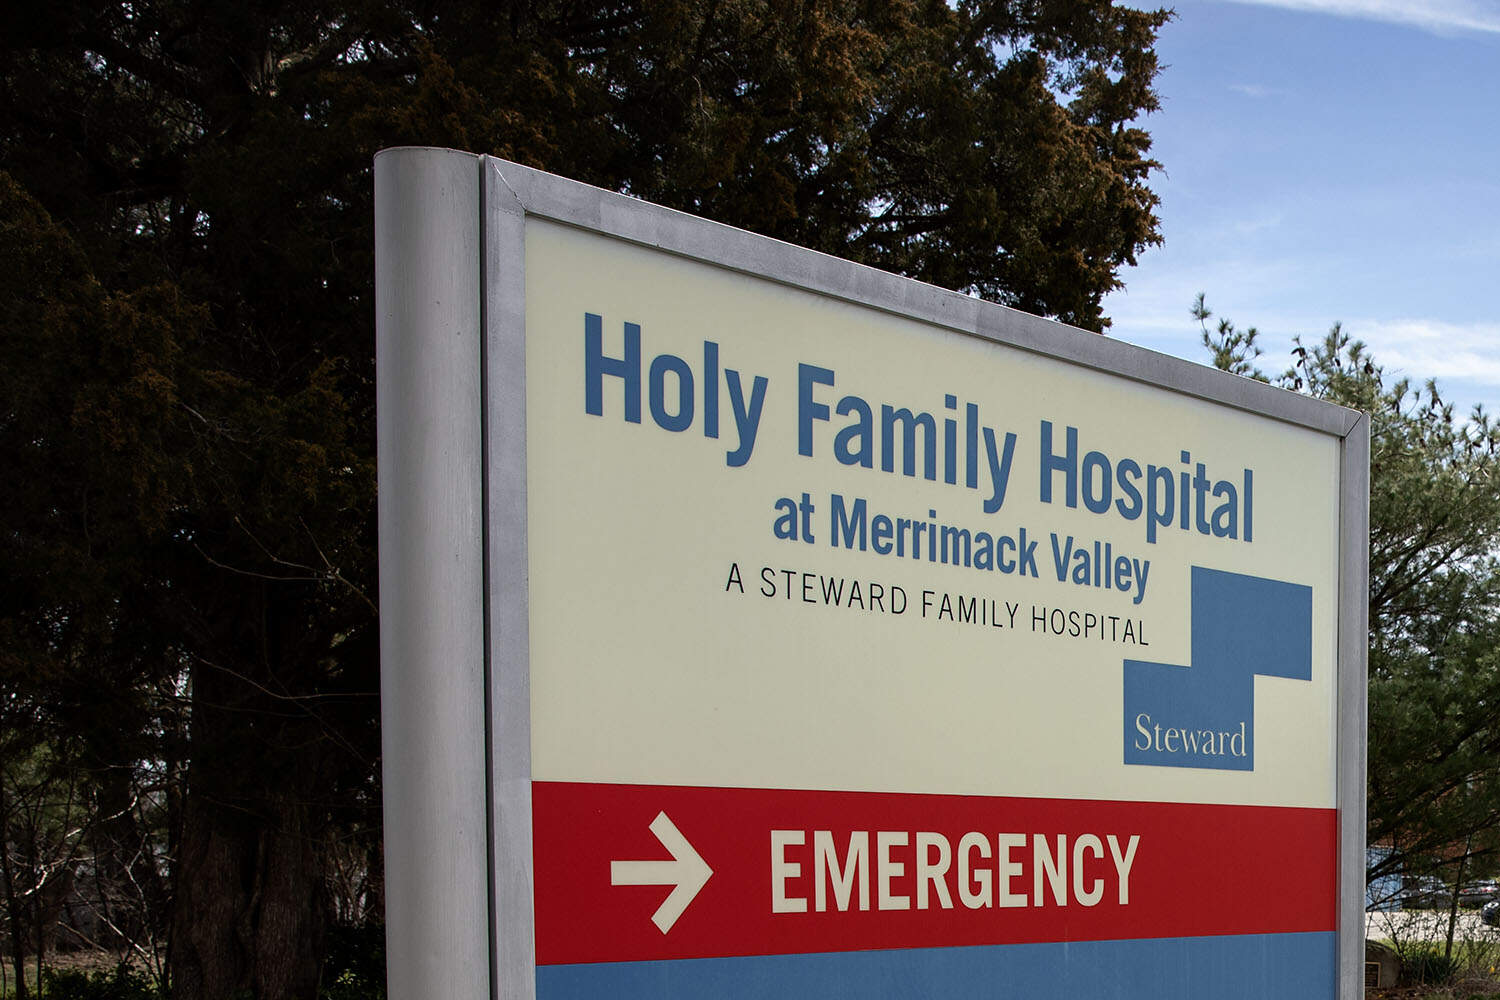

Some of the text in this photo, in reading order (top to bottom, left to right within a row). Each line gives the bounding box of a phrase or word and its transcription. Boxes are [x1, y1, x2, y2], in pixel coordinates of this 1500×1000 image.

[584, 312, 1254, 544] Holy Family Hospital
[773, 492, 1150, 605] at Merrimack Valley
[725, 562, 1150, 647] A STEWARD FAMILY HOSPITAL
[1134, 713, 1248, 758] Steward
[771, 830, 1141, 913] EMERGENCY
